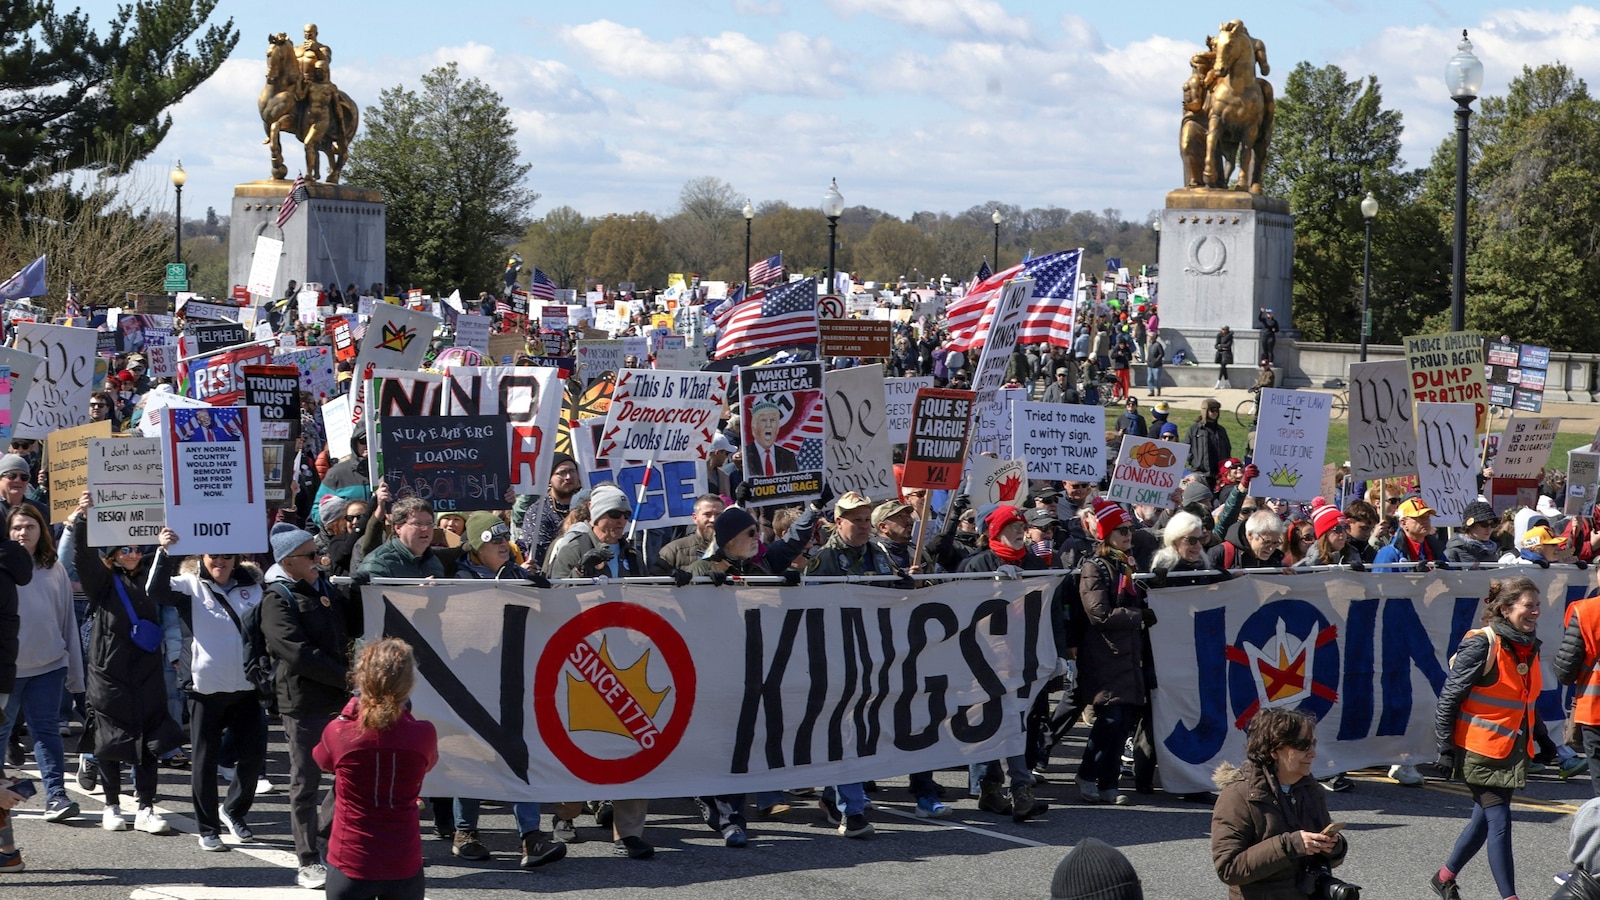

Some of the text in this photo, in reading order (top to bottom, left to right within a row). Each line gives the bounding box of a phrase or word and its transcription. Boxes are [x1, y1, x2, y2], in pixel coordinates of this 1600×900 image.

[1007, 287, 1026, 311] NO
[990, 322, 1020, 351] KINGS
[1409, 334, 1482, 353] MAKE AMERICA
[151, 348, 163, 356] NO
[588, 349, 620, 359] PRESIDENT
[1410, 353, 1448, 370] PROUD
[1451, 349, 1482, 366] AGAIN
[154, 365, 167, 373] NO
[581, 359, 619, 370] OBAMA
[194, 354, 267, 400] RESIS
[755, 367, 808, 382] WAKE UP
[1412, 367, 1473, 390] DUMP
[247, 376, 297, 391] TRUMP
[632, 374, 712, 400] This Is What
[749, 377, 812, 394] AMERICA!
[43, 385, 71, 407] the
[253, 392, 293, 406] MUST
[1414, 382, 1484, 403] TRAITOR
[954, 400, 969, 417] SE
[1271, 393, 1326, 410] RULE OF LAW
[1352, 376, 1411, 427] We
[264, 405, 284, 419] GO
[351, 405, 364, 425] NO
[616, 400, 712, 430] Democracy
[1024, 410, 1096, 424] Tried to make
[915, 418, 967, 438] LARGUE
[1277, 427, 1305, 439] TRUMPS
[1515, 423, 1526, 431] NO
[623, 427, 690, 452] Looks Like
[1030, 428, 1091, 443] a witty sign.
[1375, 423, 1398, 449] the
[1512, 434, 1522, 442] NO
[60, 439, 77, 452] know
[102, 444, 157, 457] I don't want
[916, 438, 962, 458] TRUMP
[1024, 443, 1098, 459] Forgot TRUMP
[1269, 443, 1315, 459] RULE OF ONE
[1419, 418, 1471, 472] We
[1508, 444, 1518, 452] NO
[54, 458, 70, 470] make
[415, 448, 479, 464] LOADING
[832, 443, 863, 471] the
[1357, 442, 1415, 474] People
[1504, 456, 1534, 465] THIS IS
[104, 460, 129, 472] Person
[133, 463, 143, 471] as
[186, 461, 215, 469] WOULD
[193, 468, 231, 476] REMOVED
[1026, 461, 1062, 474] CAN'T
[1065, 463, 1098, 477] READ.
[1573, 460, 1596, 470] GEORGE
[753, 473, 813, 486] Democracy needs
[927, 466, 950, 483] YA!
[984, 475, 995, 487] NO
[1115, 464, 1175, 488] CONGRESS
[1440, 468, 1461, 494] the
[54, 477, 76, 492] They're
[193, 483, 221, 491] OFFICE
[750, 485, 776, 497] YOUR
[1112, 484, 1133, 500] GET
[97, 489, 140, 503] Neither do
[203, 490, 225, 498] NOW.
[433, 499, 456, 511] ICE
[97, 510, 144, 522] RESIGN MR
[193, 523, 231, 538] IDIOT
[382, 589, 1043, 786] NO KINGS!
[1162, 596, 1480, 766] JOIN
[569, 642, 659, 751] SINCE 1776
